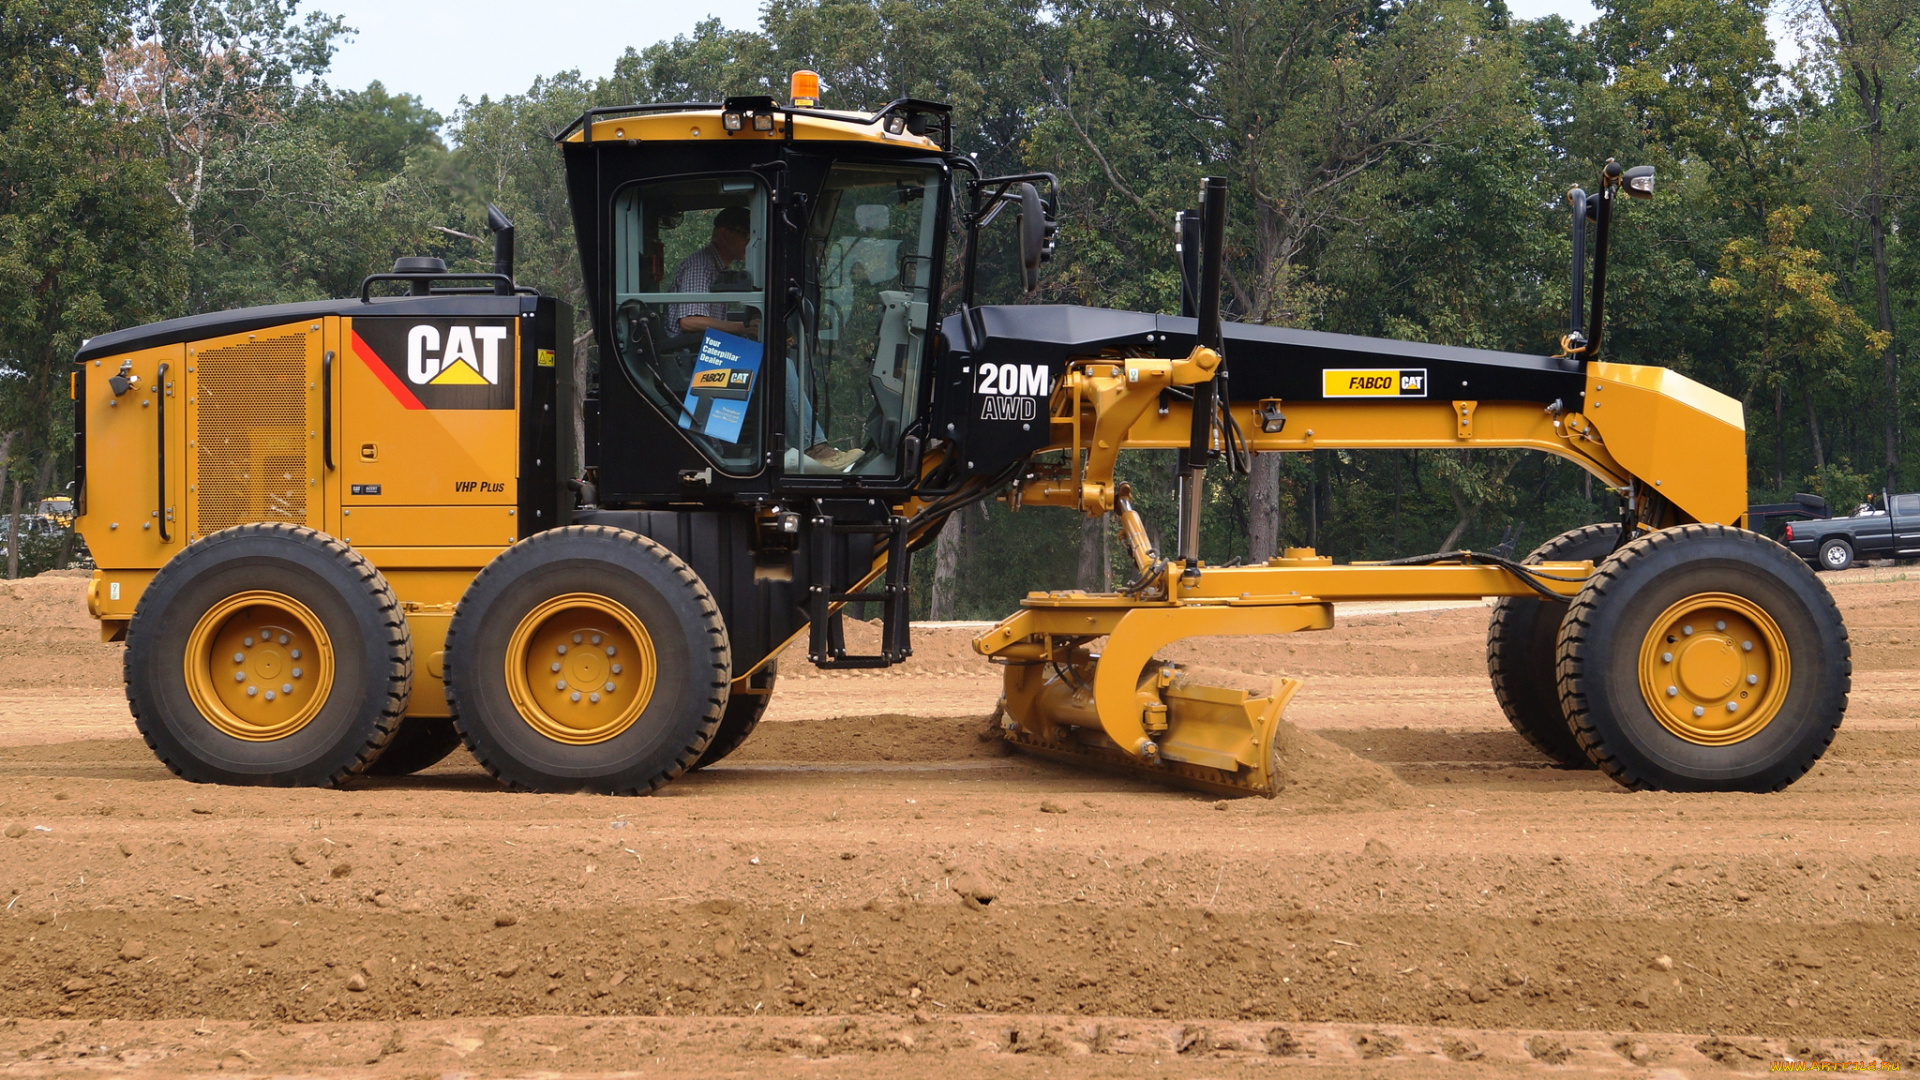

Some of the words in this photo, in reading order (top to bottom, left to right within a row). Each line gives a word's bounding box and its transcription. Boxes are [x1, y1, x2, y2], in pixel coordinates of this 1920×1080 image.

[705, 336, 721, 348] Your
[407, 324, 507, 385] CAT
[699, 353, 723, 367] Dealer
[702, 345, 739, 362] Caterpillar
[700, 372, 726, 383] FABCO
[730, 372, 749, 384] CAT
[973, 362, 1049, 397] 20M
[1349, 376, 1393, 390] FABCO
[1401, 376, 1424, 390] CAT
[980, 395, 1037, 421] AWD
[455, 481, 477, 493] VHP
